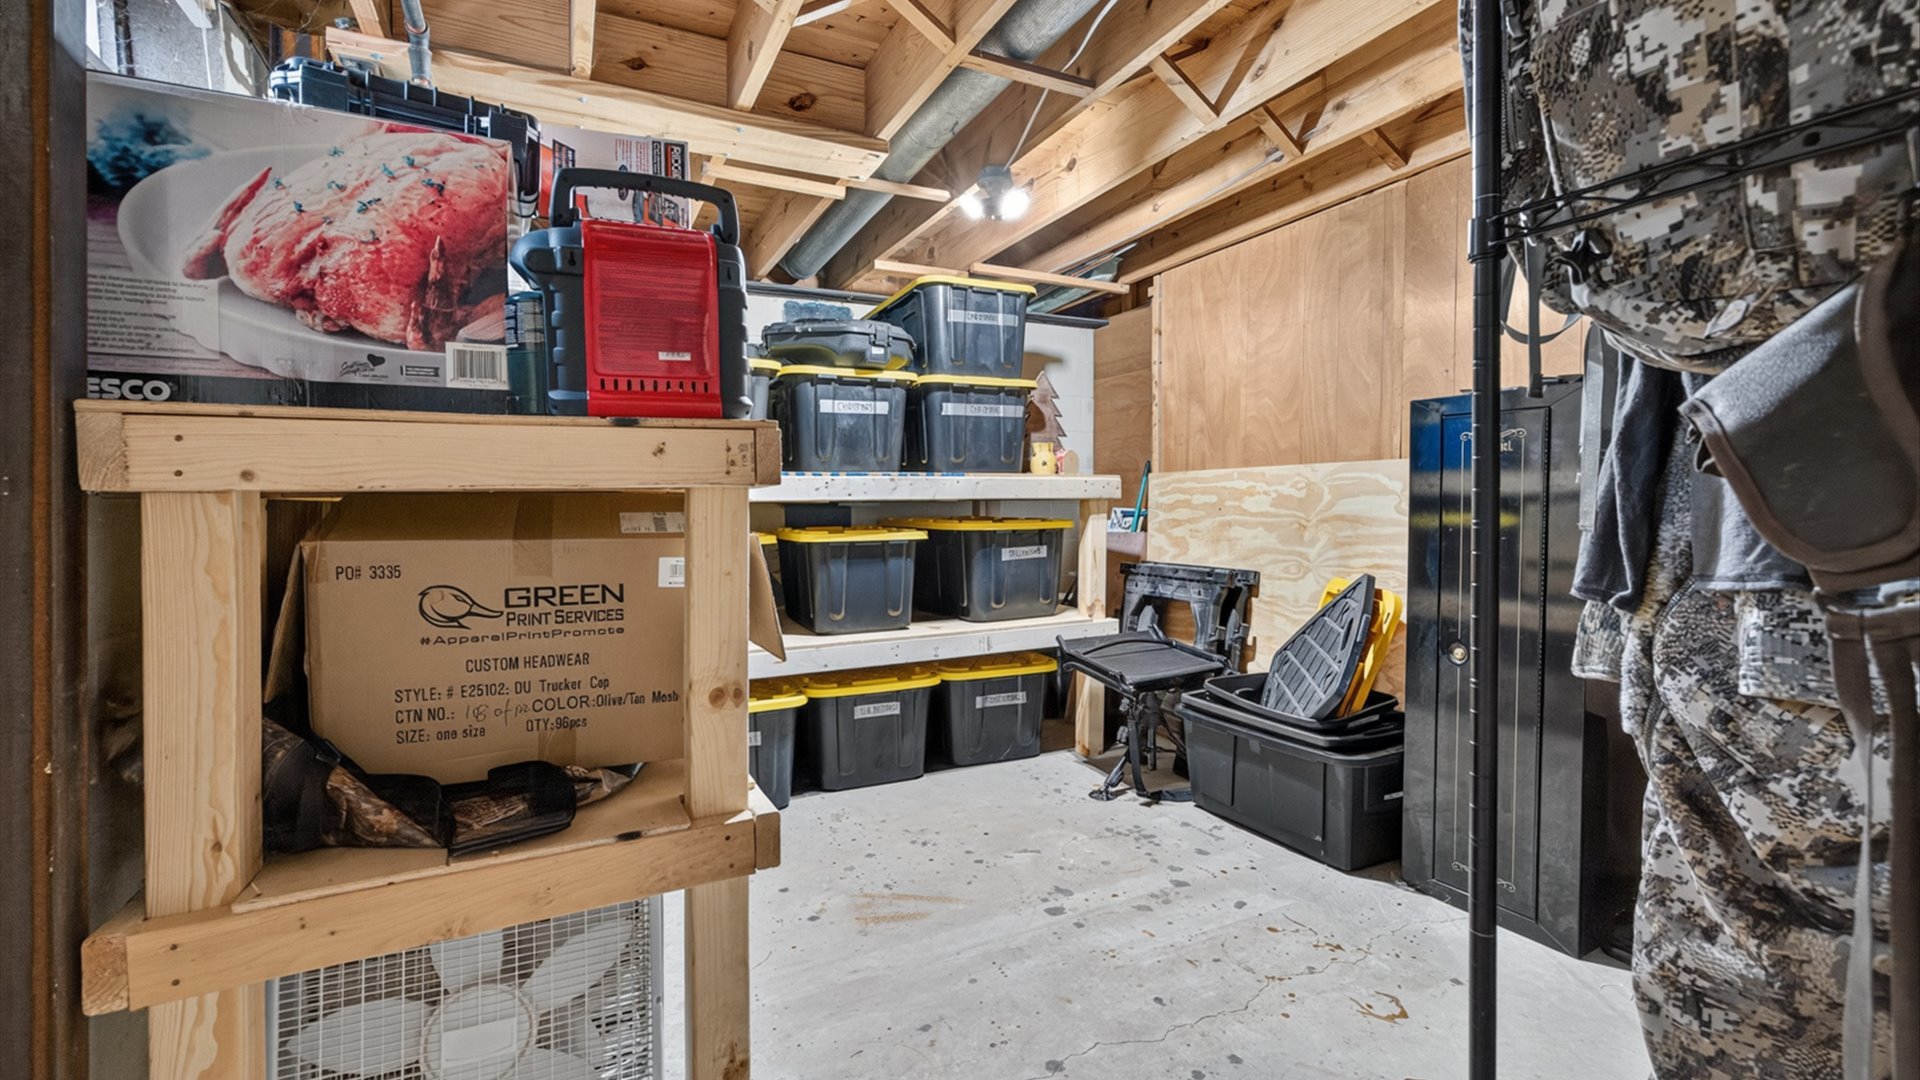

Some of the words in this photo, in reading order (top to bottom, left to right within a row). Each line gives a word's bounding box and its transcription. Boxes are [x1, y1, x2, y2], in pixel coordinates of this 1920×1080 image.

[335, 566, 362, 581] PO#
[368, 565, 402, 580] 3335
[504, 583, 624, 609] GREEN
[506, 612, 551, 627] PRINT
[554, 608, 625, 624] SERVICES
[419, 626, 625, 646] #ApparelPrintPromote
[465, 658, 519, 673] CUSTOM
[523, 652, 590, 669] HEADWEAR
[394, 687, 442, 704] STYLE:
[446, 685, 454, 699] #
[460, 682, 510, 698] E25102:
[514, 680, 532, 695] DU
[539, 678, 582, 693] Trucker
[590, 675, 609, 690] Cap
[395, 709, 423, 724] CTN
[427, 706, 455, 721] NO.:
[396, 728, 430, 745] SIZE:
[436, 729, 458, 741] one
[462, 724, 486, 738] size
